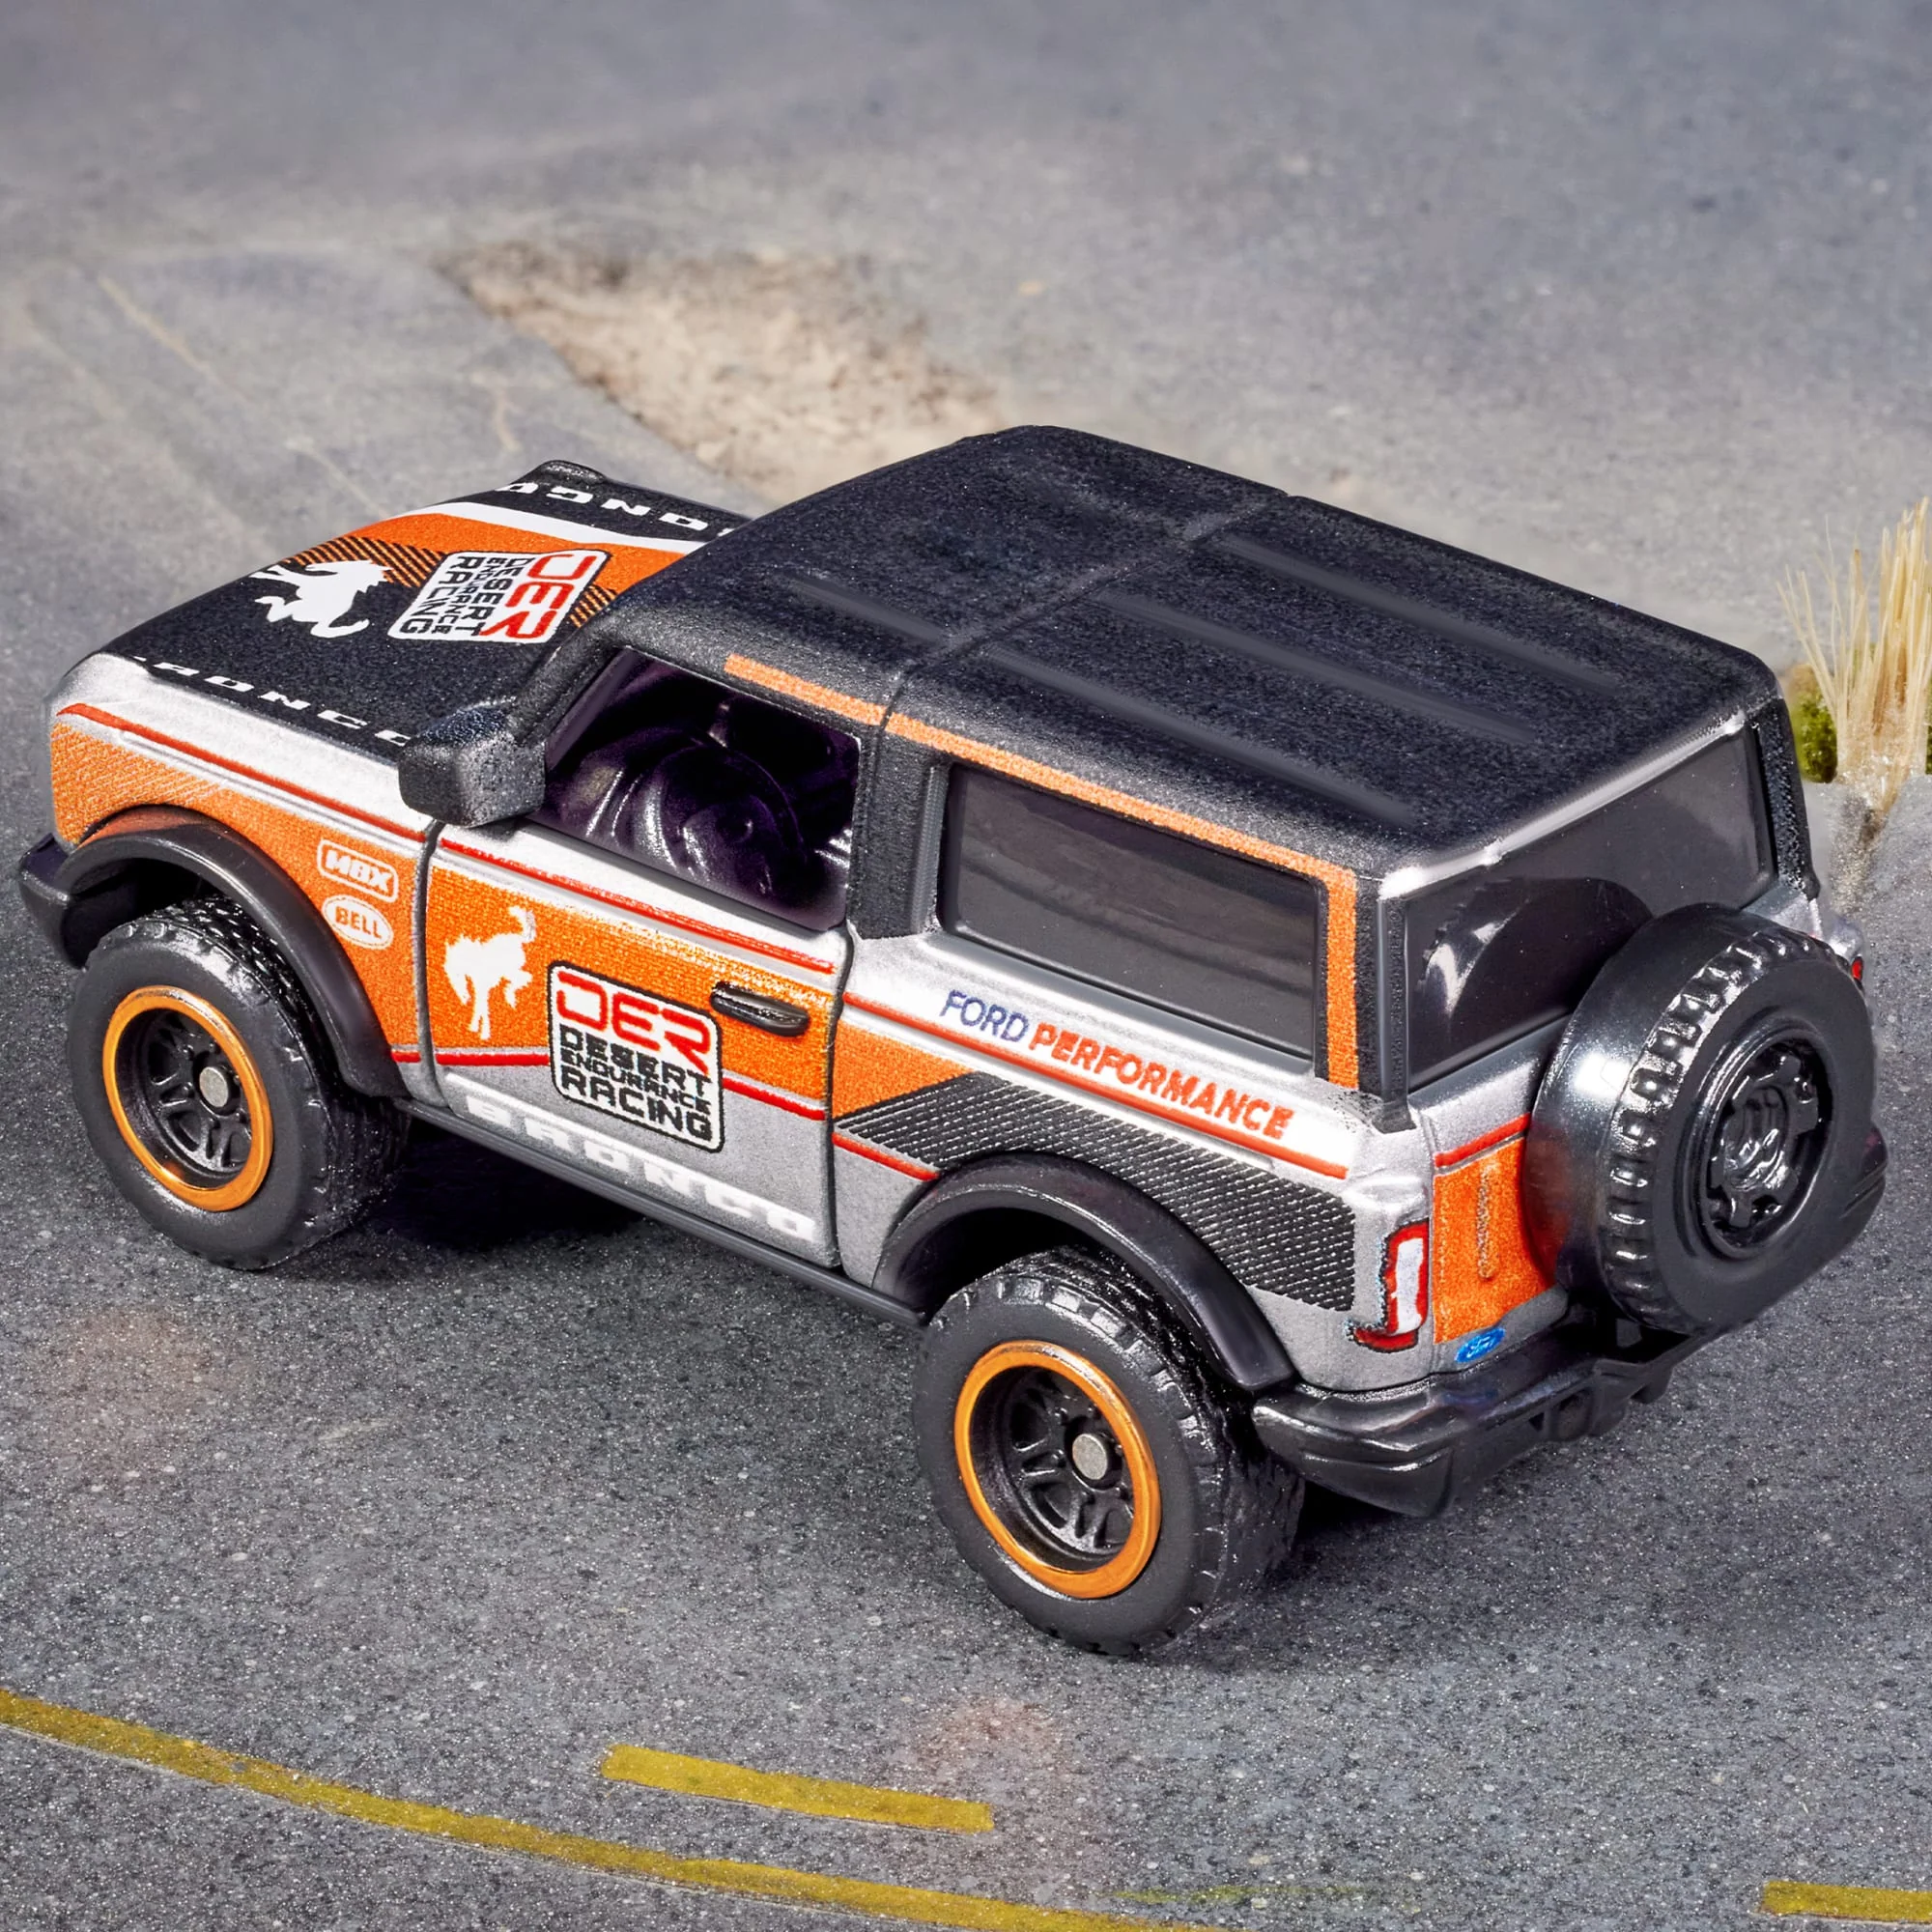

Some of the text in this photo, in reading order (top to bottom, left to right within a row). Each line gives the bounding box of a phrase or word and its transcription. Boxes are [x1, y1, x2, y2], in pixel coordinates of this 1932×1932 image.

[400, 556, 486, 635] RACING
[456, 557, 535, 636] DESERT
[479, 554, 597, 639] DER
[134, 657, 412, 746] RONCO
[335, 906, 382, 940] BELL
[556, 971, 711, 1076] DER
[559, 1024, 712, 1096] DESERT
[939, 989, 1295, 1140] FORD PERFORMANCE
[560, 1065, 712, 1141] RACING
[467, 1094, 815, 1243] BRONCO
